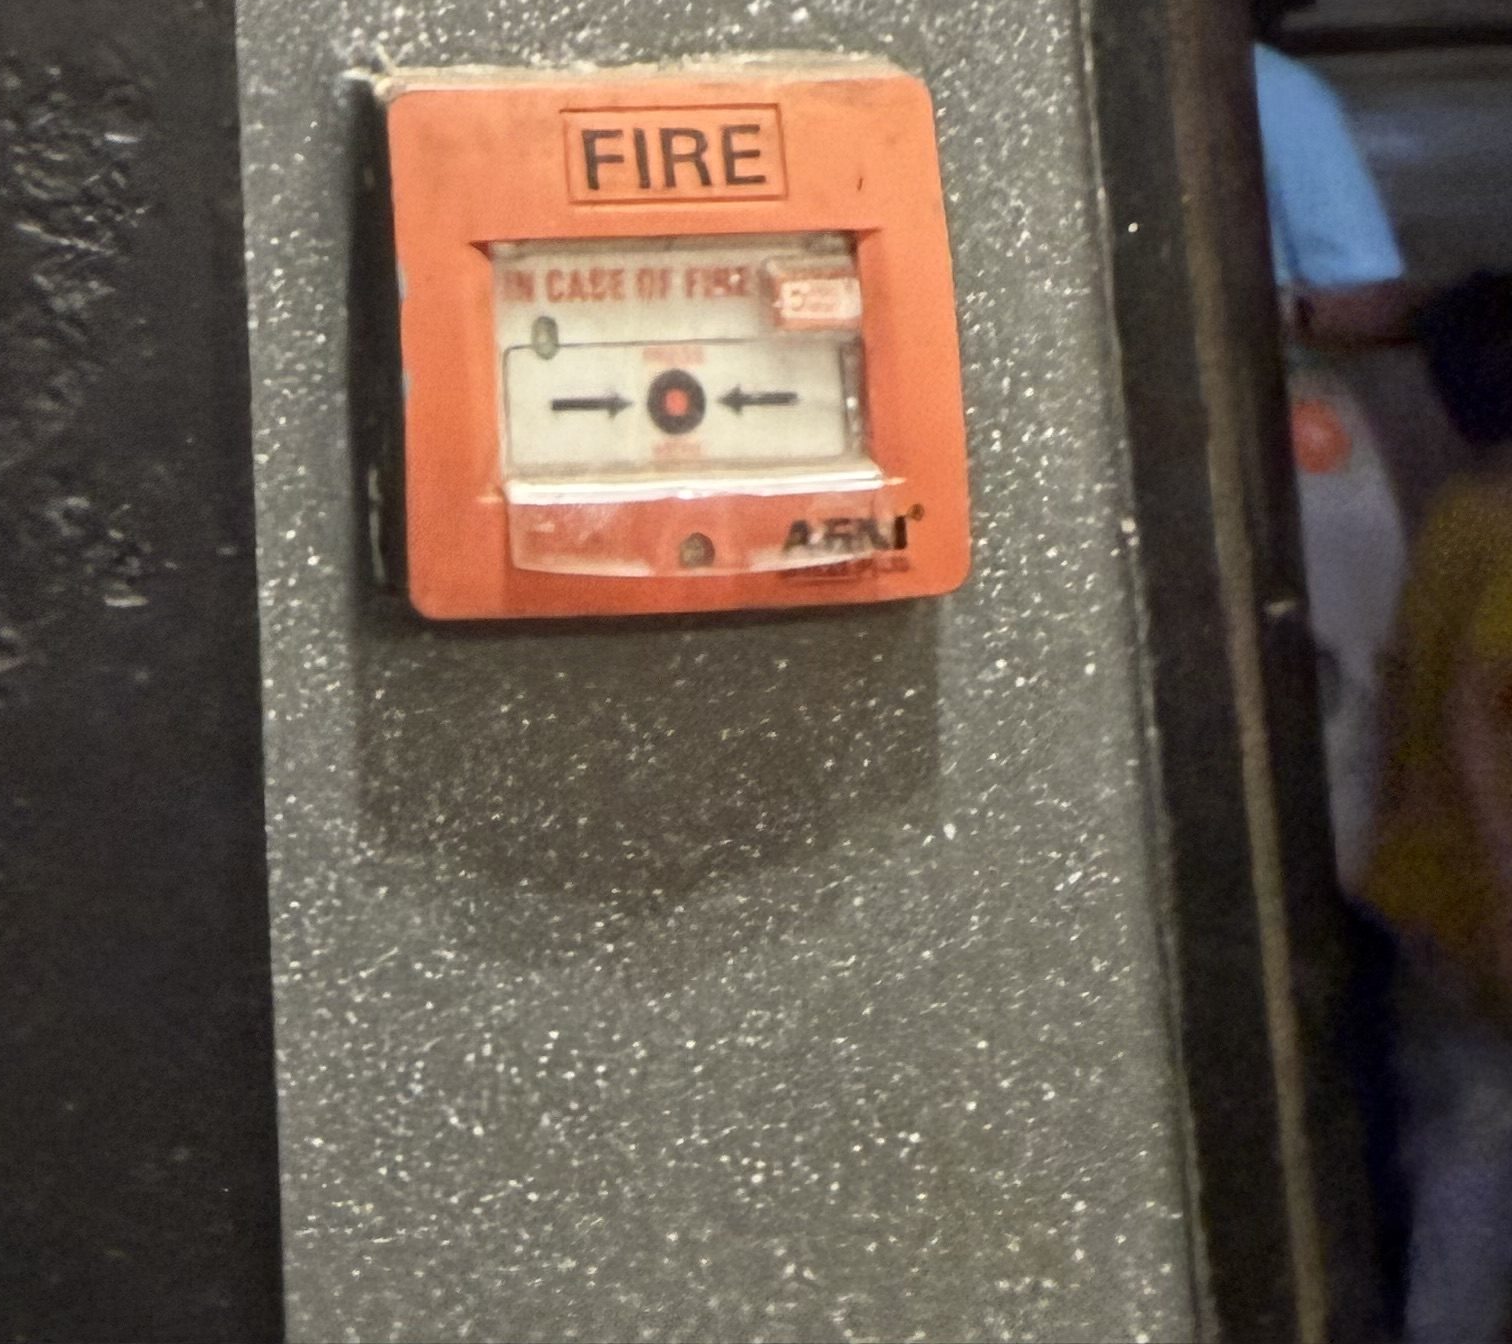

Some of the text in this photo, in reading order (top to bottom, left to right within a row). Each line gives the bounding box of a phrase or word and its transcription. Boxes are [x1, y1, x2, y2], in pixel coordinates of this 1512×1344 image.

[581, 123, 767, 190] FIRE
[502, 264, 748, 304] IN CASE OF FIRE
